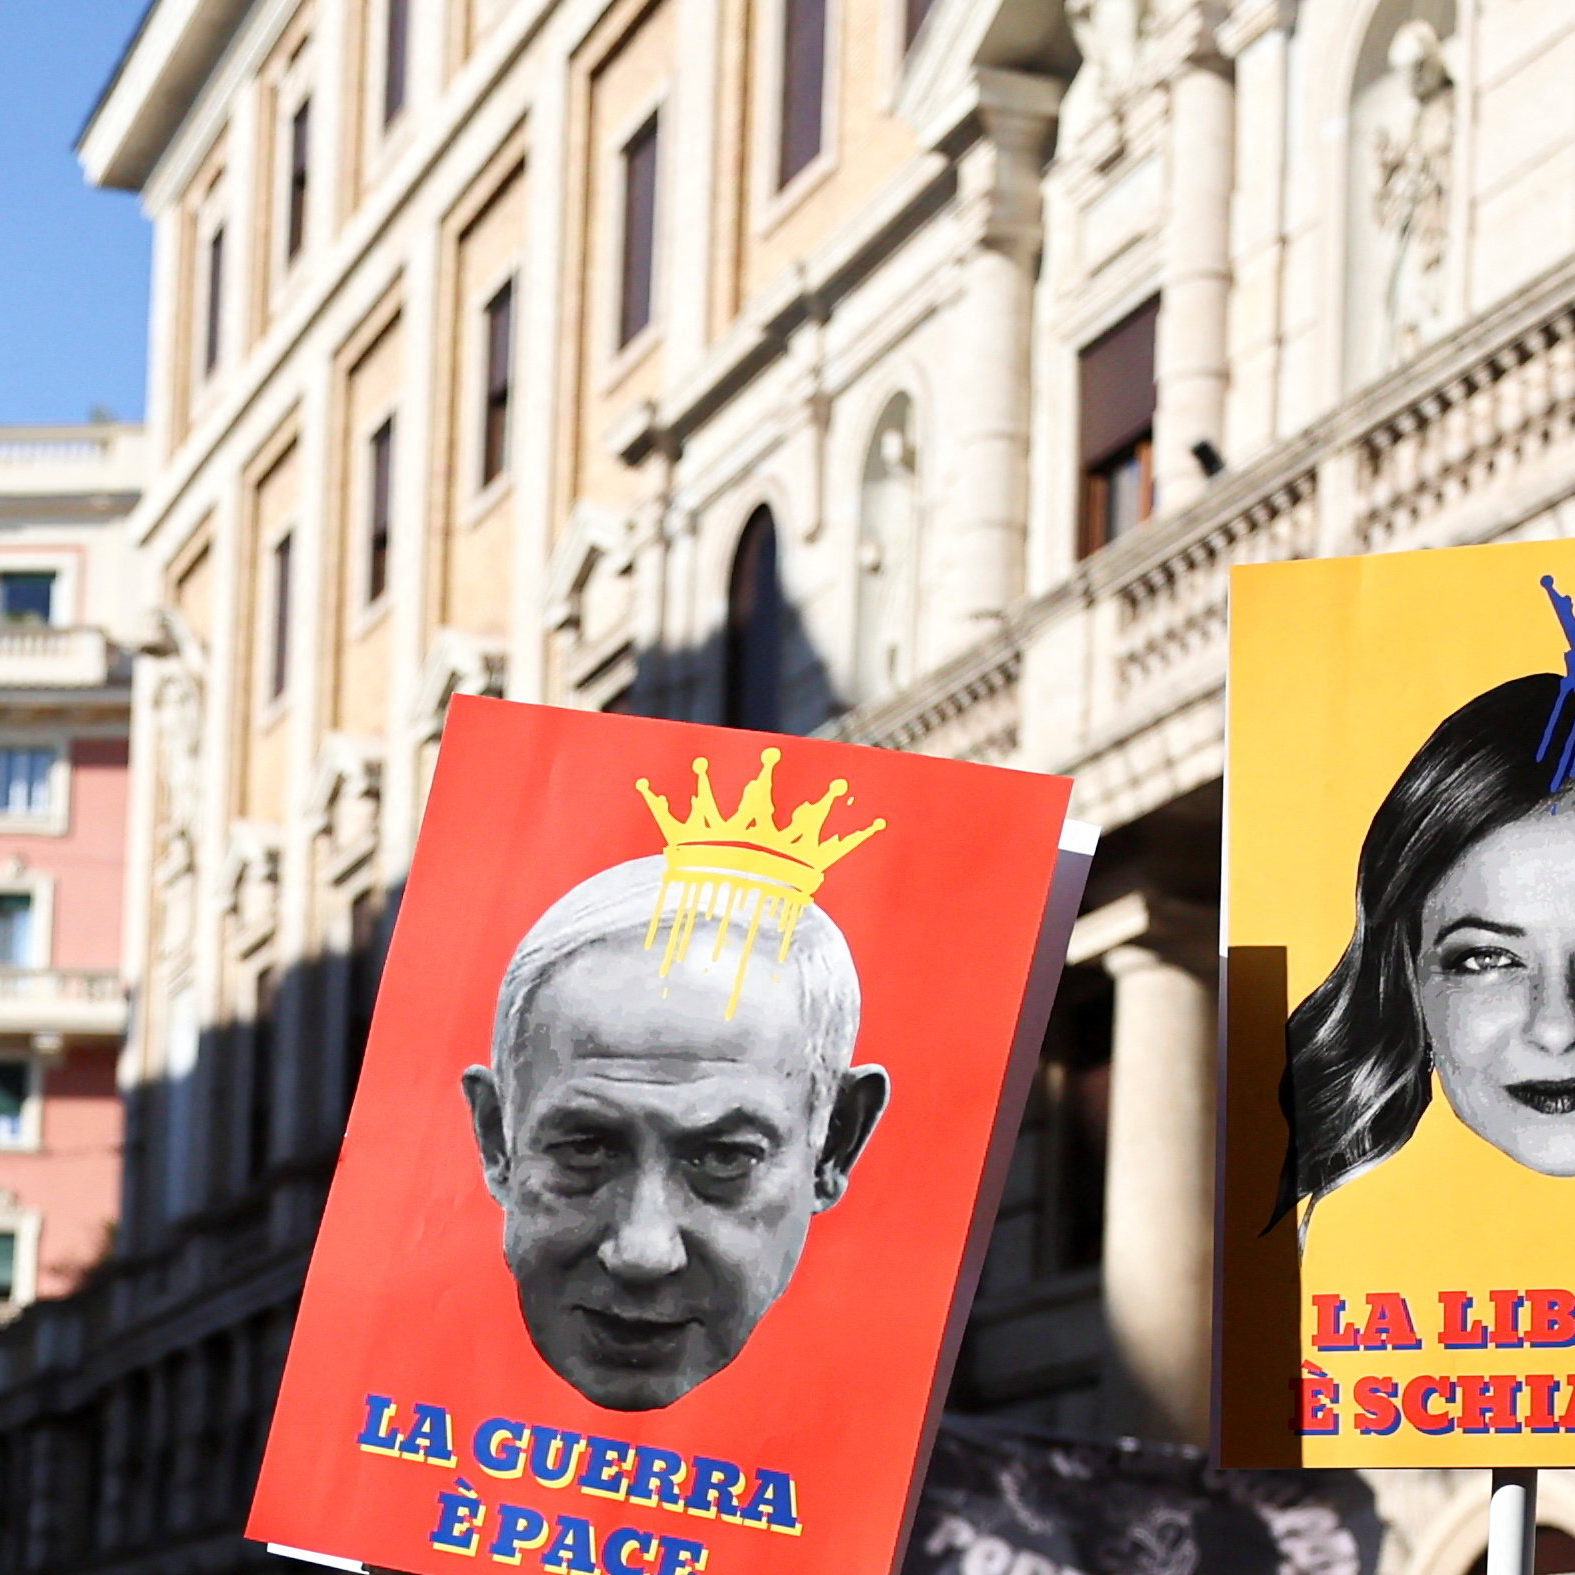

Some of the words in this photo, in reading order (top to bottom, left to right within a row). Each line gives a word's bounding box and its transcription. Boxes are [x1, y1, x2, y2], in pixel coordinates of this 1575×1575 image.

[1312, 1293, 1421, 1351] LA
[1289, 1359, 1340, 1436] È
[357, 1394, 457, 1469] LA
[473, 1418, 803, 1536] GUERRA
[431, 1478, 486, 1556] È
